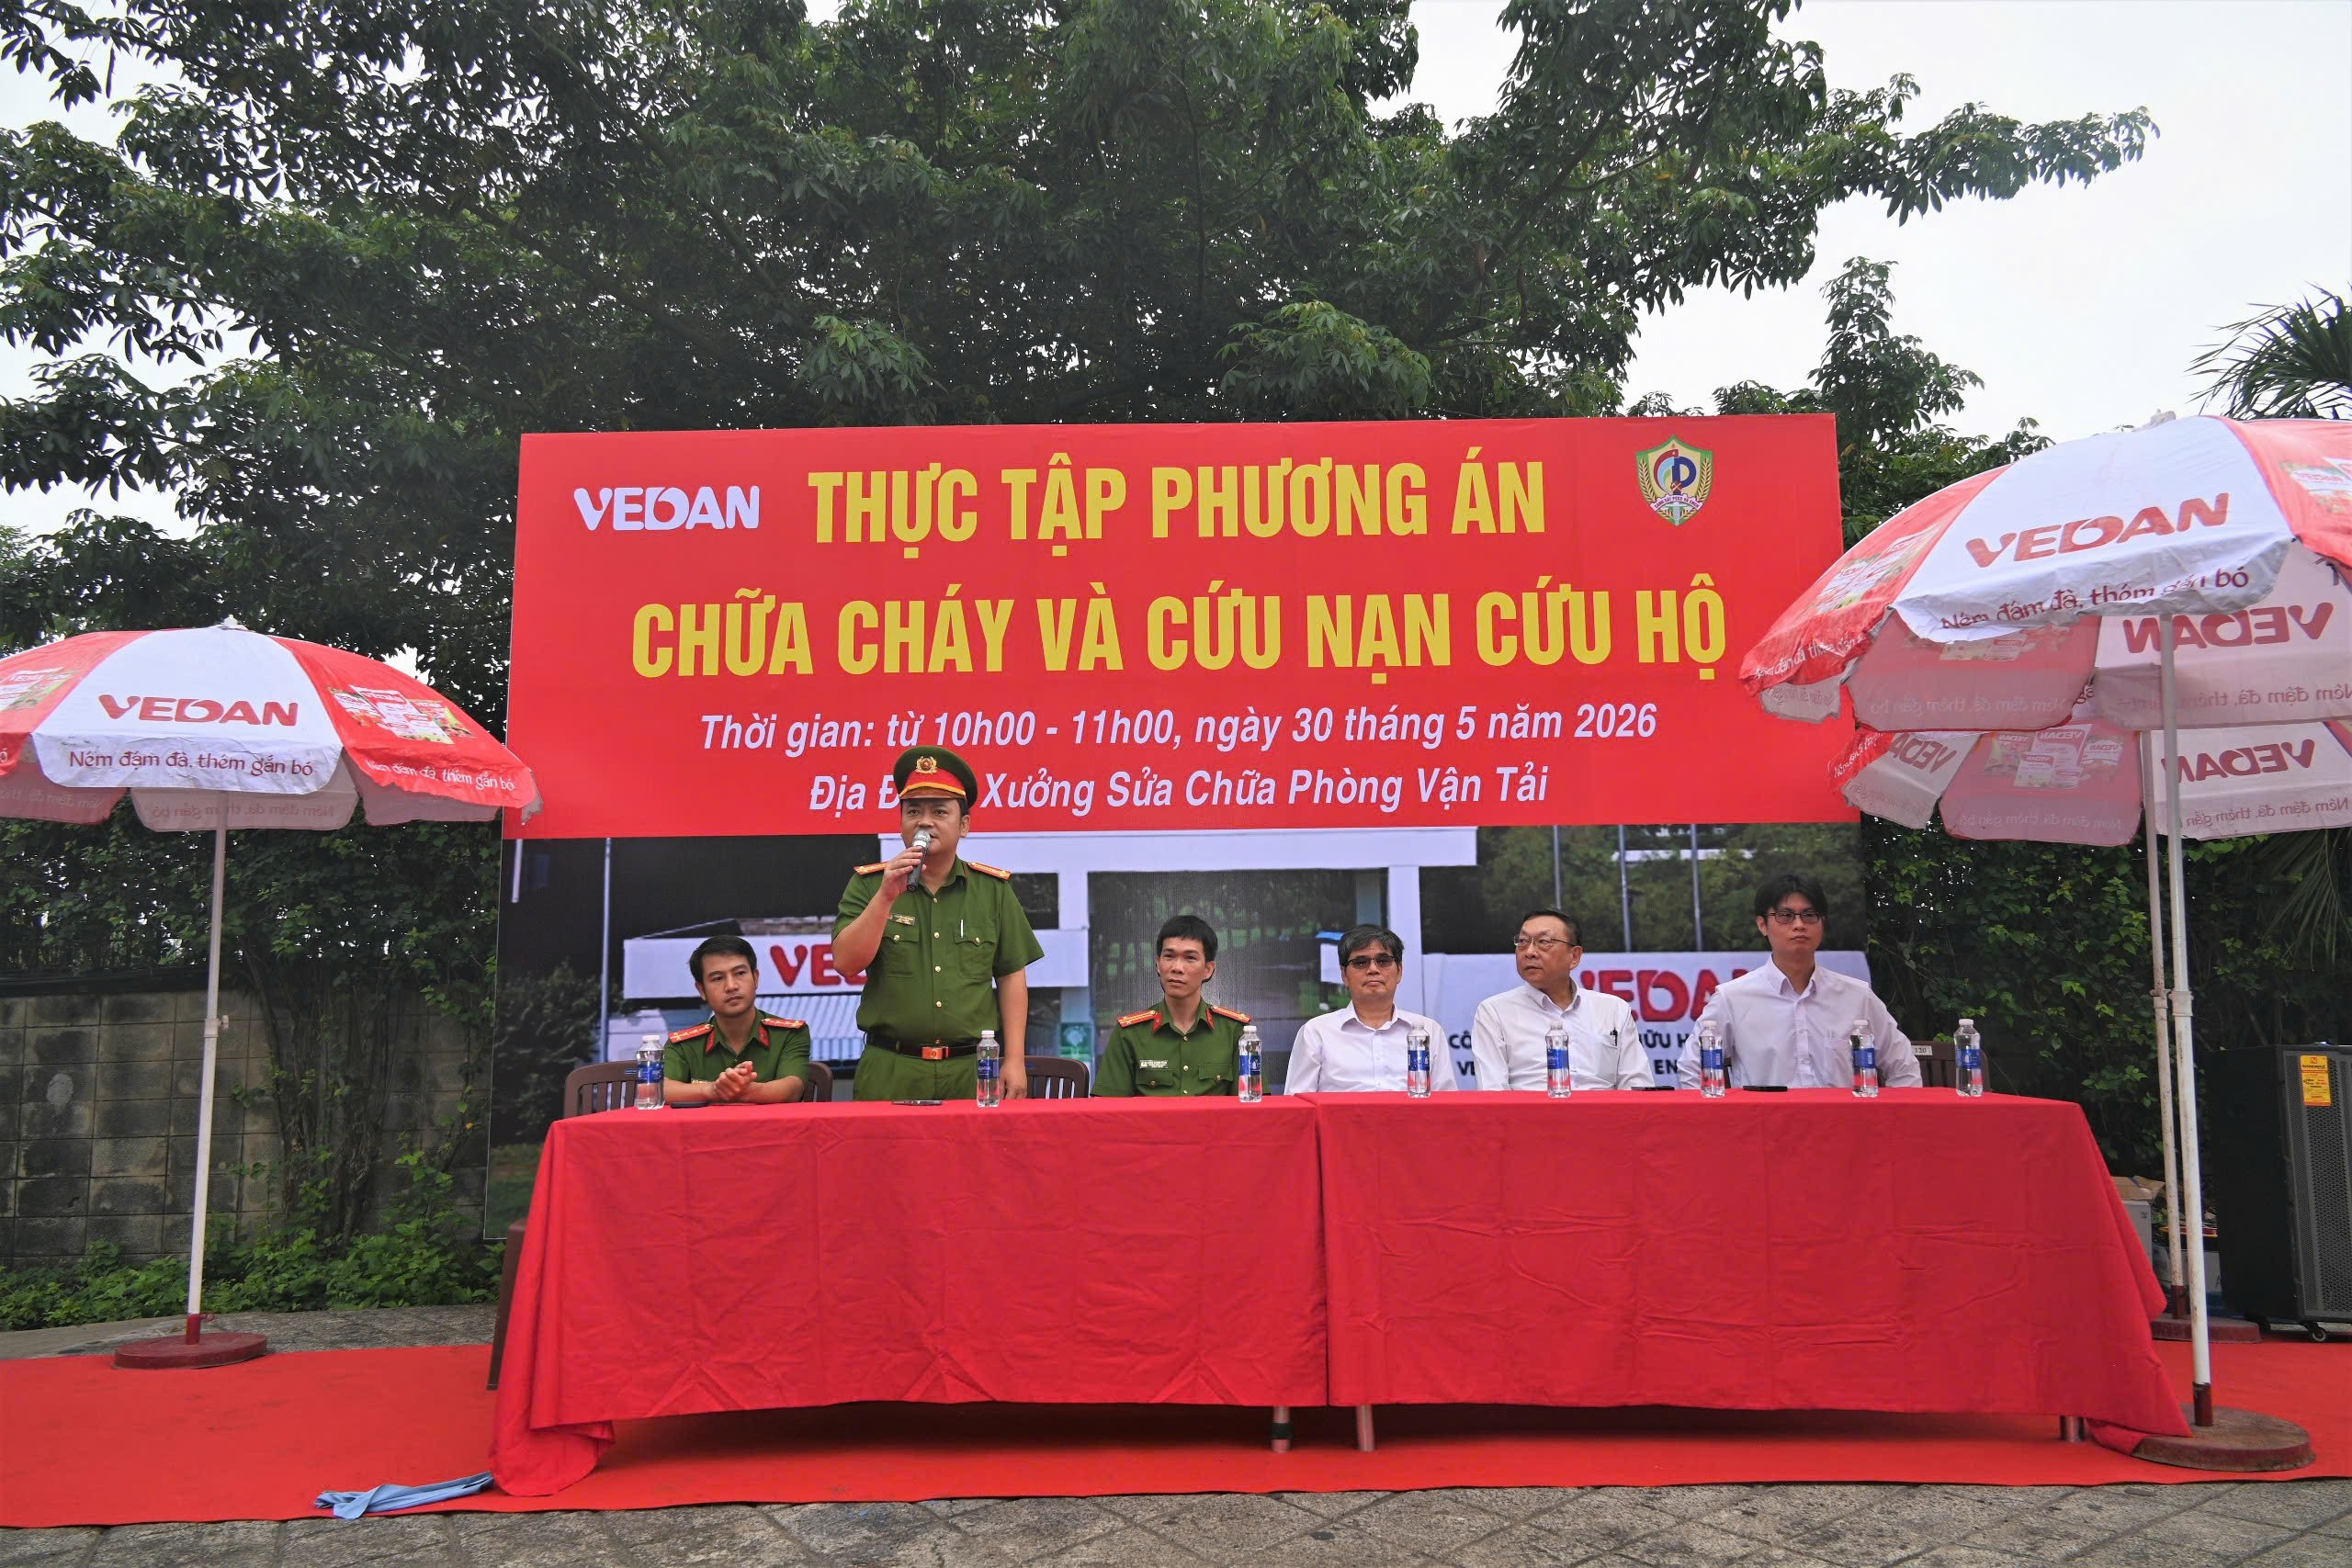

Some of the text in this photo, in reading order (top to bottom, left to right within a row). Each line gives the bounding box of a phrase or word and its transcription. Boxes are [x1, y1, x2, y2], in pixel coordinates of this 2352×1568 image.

[573, 485, 760, 531] VEDAN
[808, 446, 1545, 559] THỰC TẬP PHƯƠNG ÁN
[1965, 492, 2229, 568] VEDAN
[2215, 566, 2249, 588] bó
[632, 572, 1726, 684] CHỮA CHÁY VÀ CỨU NẠN CỨU HỘ
[98, 694, 299, 727] VEDAN
[701, 703, 1657, 758] Thời gian: từ 10h00 - 11h00, ngày 30 tháng 5 năm 2026
[0, 747, 8, 762] ó
[250, 754, 286, 777] gắn
[291, 759, 313, 776] bó
[808, 774, 866, 818] Địa
[979, 767, 1095, 817] Xưởng
[1106, 765, 1173, 807] Sửa
[1185, 769, 1276, 807] Chữa
[1288, 767, 1403, 813] Phòng
[1418, 766, 1481, 810] Vận
[1496, 761, 1549, 802] Tải
